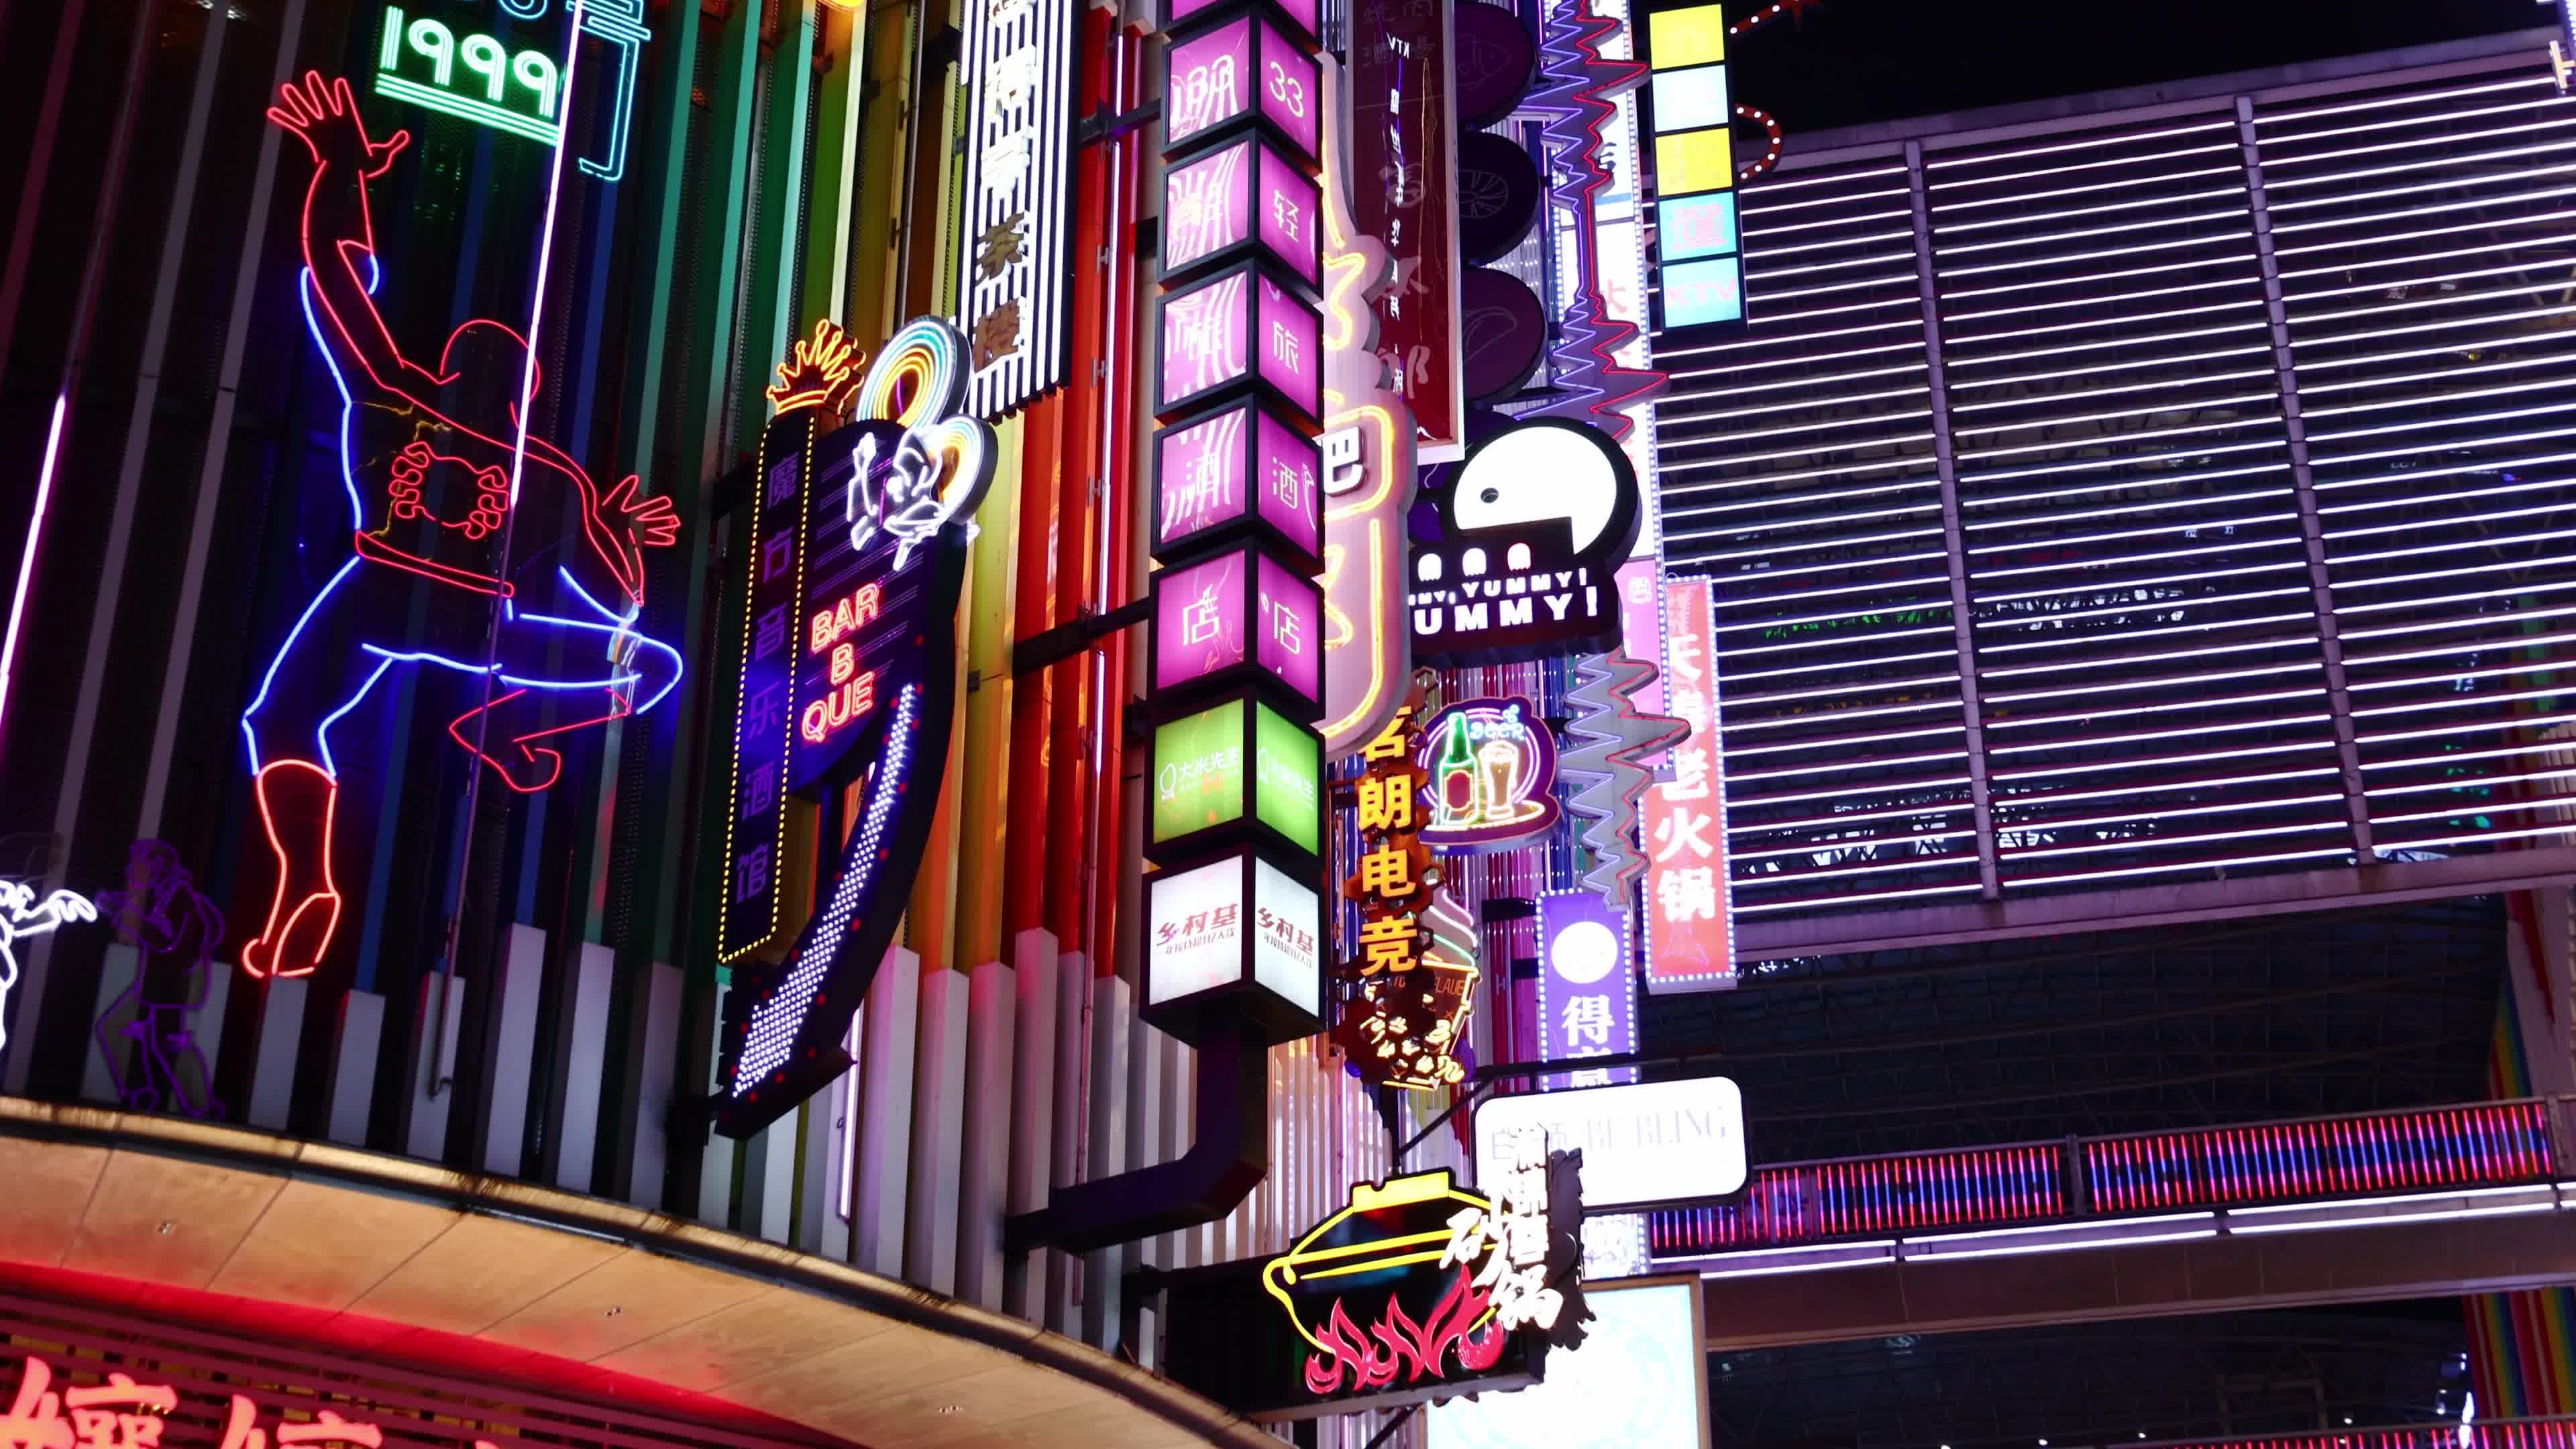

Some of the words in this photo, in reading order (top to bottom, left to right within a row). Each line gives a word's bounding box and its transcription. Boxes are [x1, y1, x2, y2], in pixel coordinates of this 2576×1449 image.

[380, 5, 557, 118] 1999
[1461, 567, 1588, 599] YUMMY!
[809, 582, 883, 653] BAR
[736, 451, 800, 905] 魔方音乐酒馆
[829, 642, 855, 686] B
[801, 670, 875, 743] QUE
[1179, 747, 1240, 782] 大米先生
[1156, 902, 1238, 947] 乡村基
[1256, 906, 1314, 957] 乡村基
